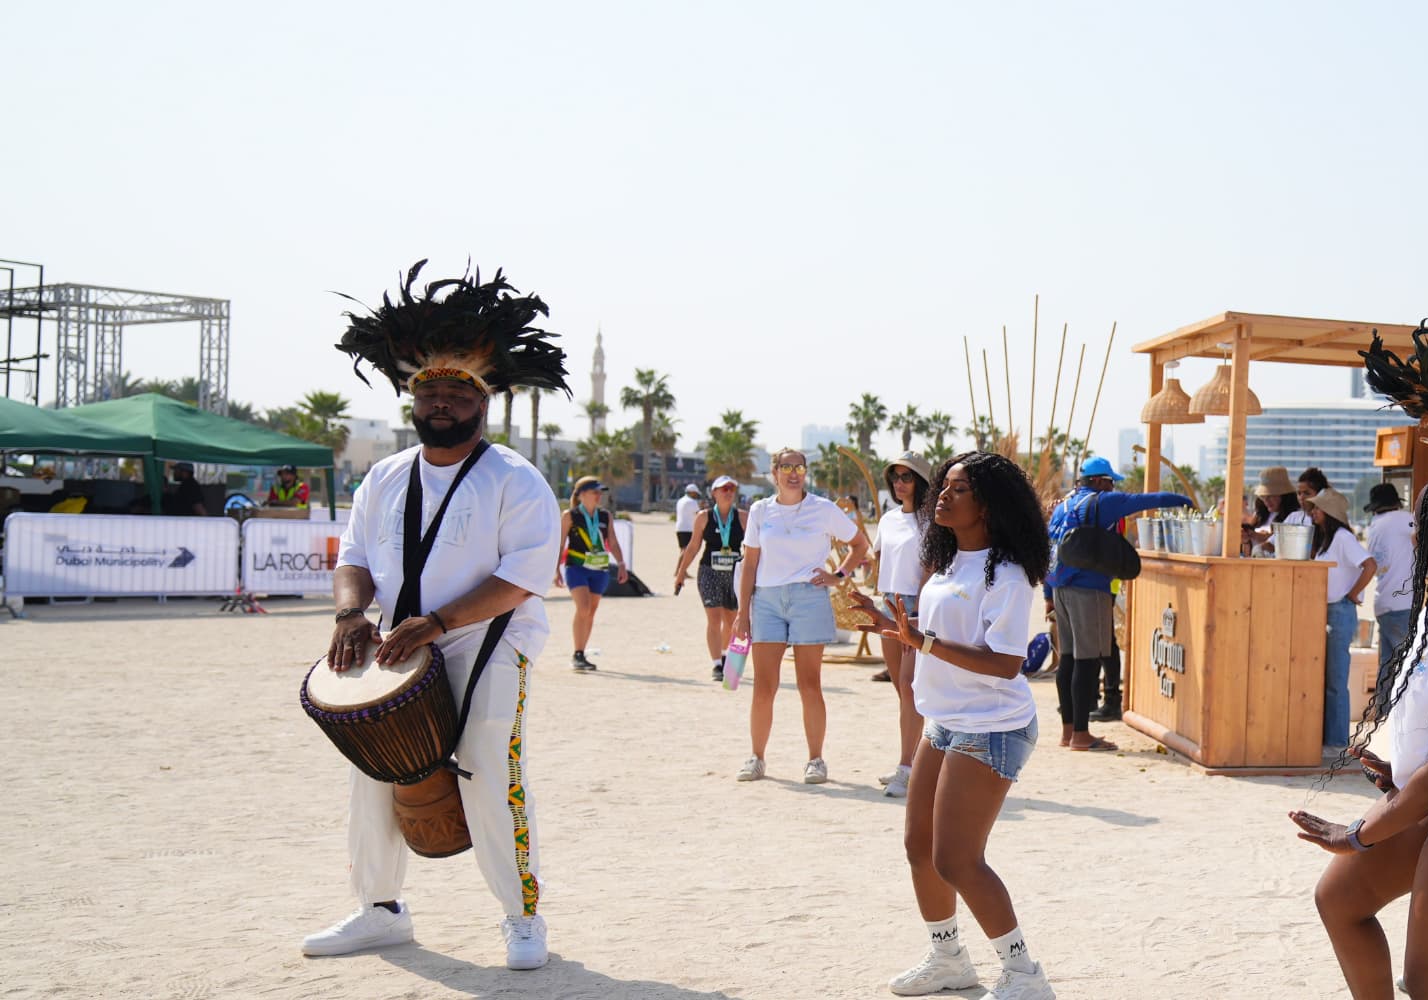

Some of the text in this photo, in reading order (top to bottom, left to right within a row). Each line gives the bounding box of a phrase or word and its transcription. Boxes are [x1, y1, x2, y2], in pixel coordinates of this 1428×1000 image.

[55, 556, 166, 568] Dubai Municipality
[253, 552, 278, 571] LA
